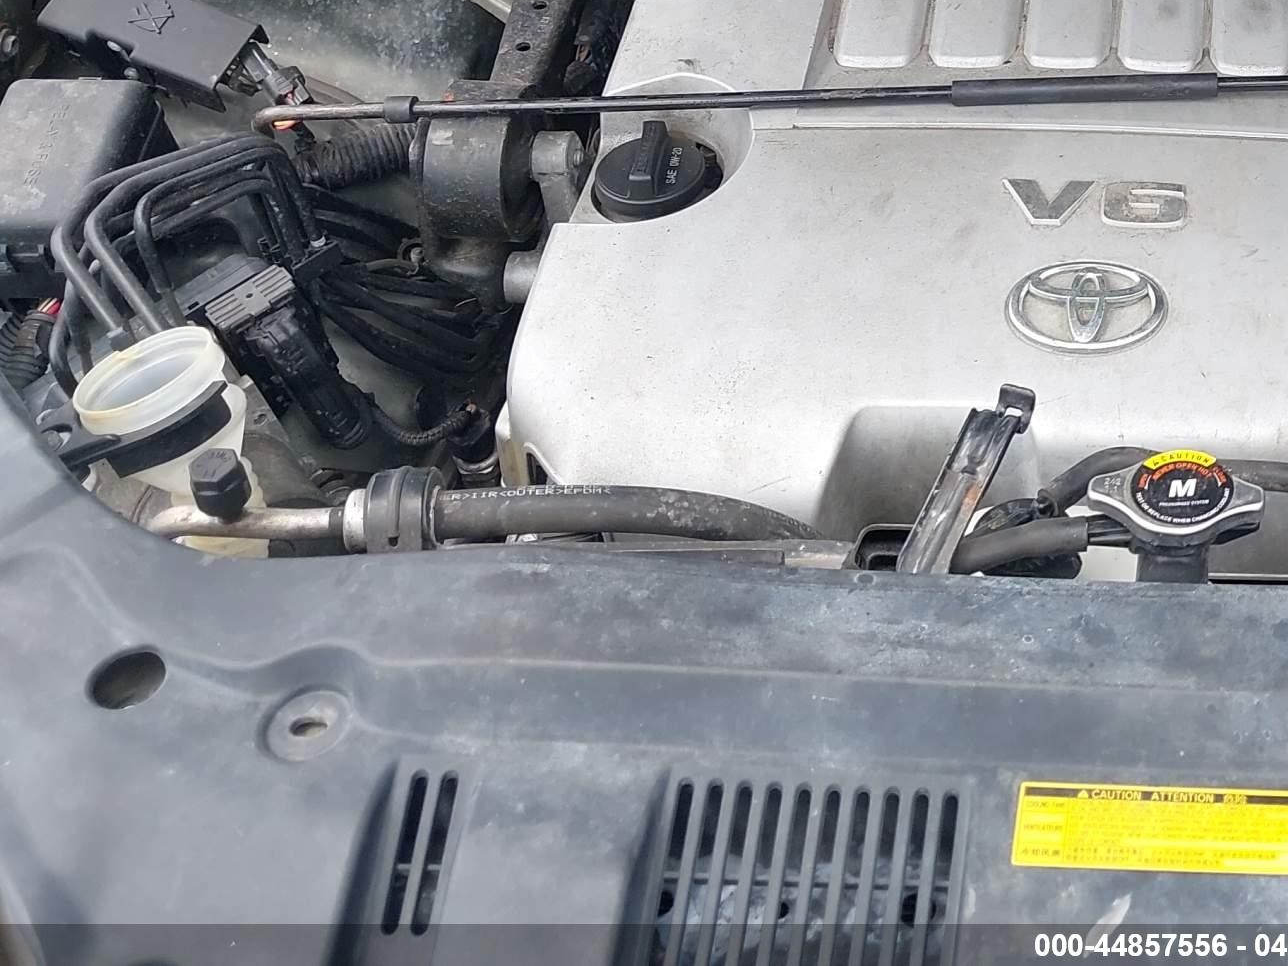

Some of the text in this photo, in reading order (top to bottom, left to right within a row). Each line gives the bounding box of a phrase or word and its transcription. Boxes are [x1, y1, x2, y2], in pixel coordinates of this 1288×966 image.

[665, 169, 677, 184] SAE
[1001, 178, 1187, 229] V6
[1167, 478, 1198, 498] M
[1091, 790, 1142, 801] CAUTION
[1150, 791, 1215, 803] ATTENTION
